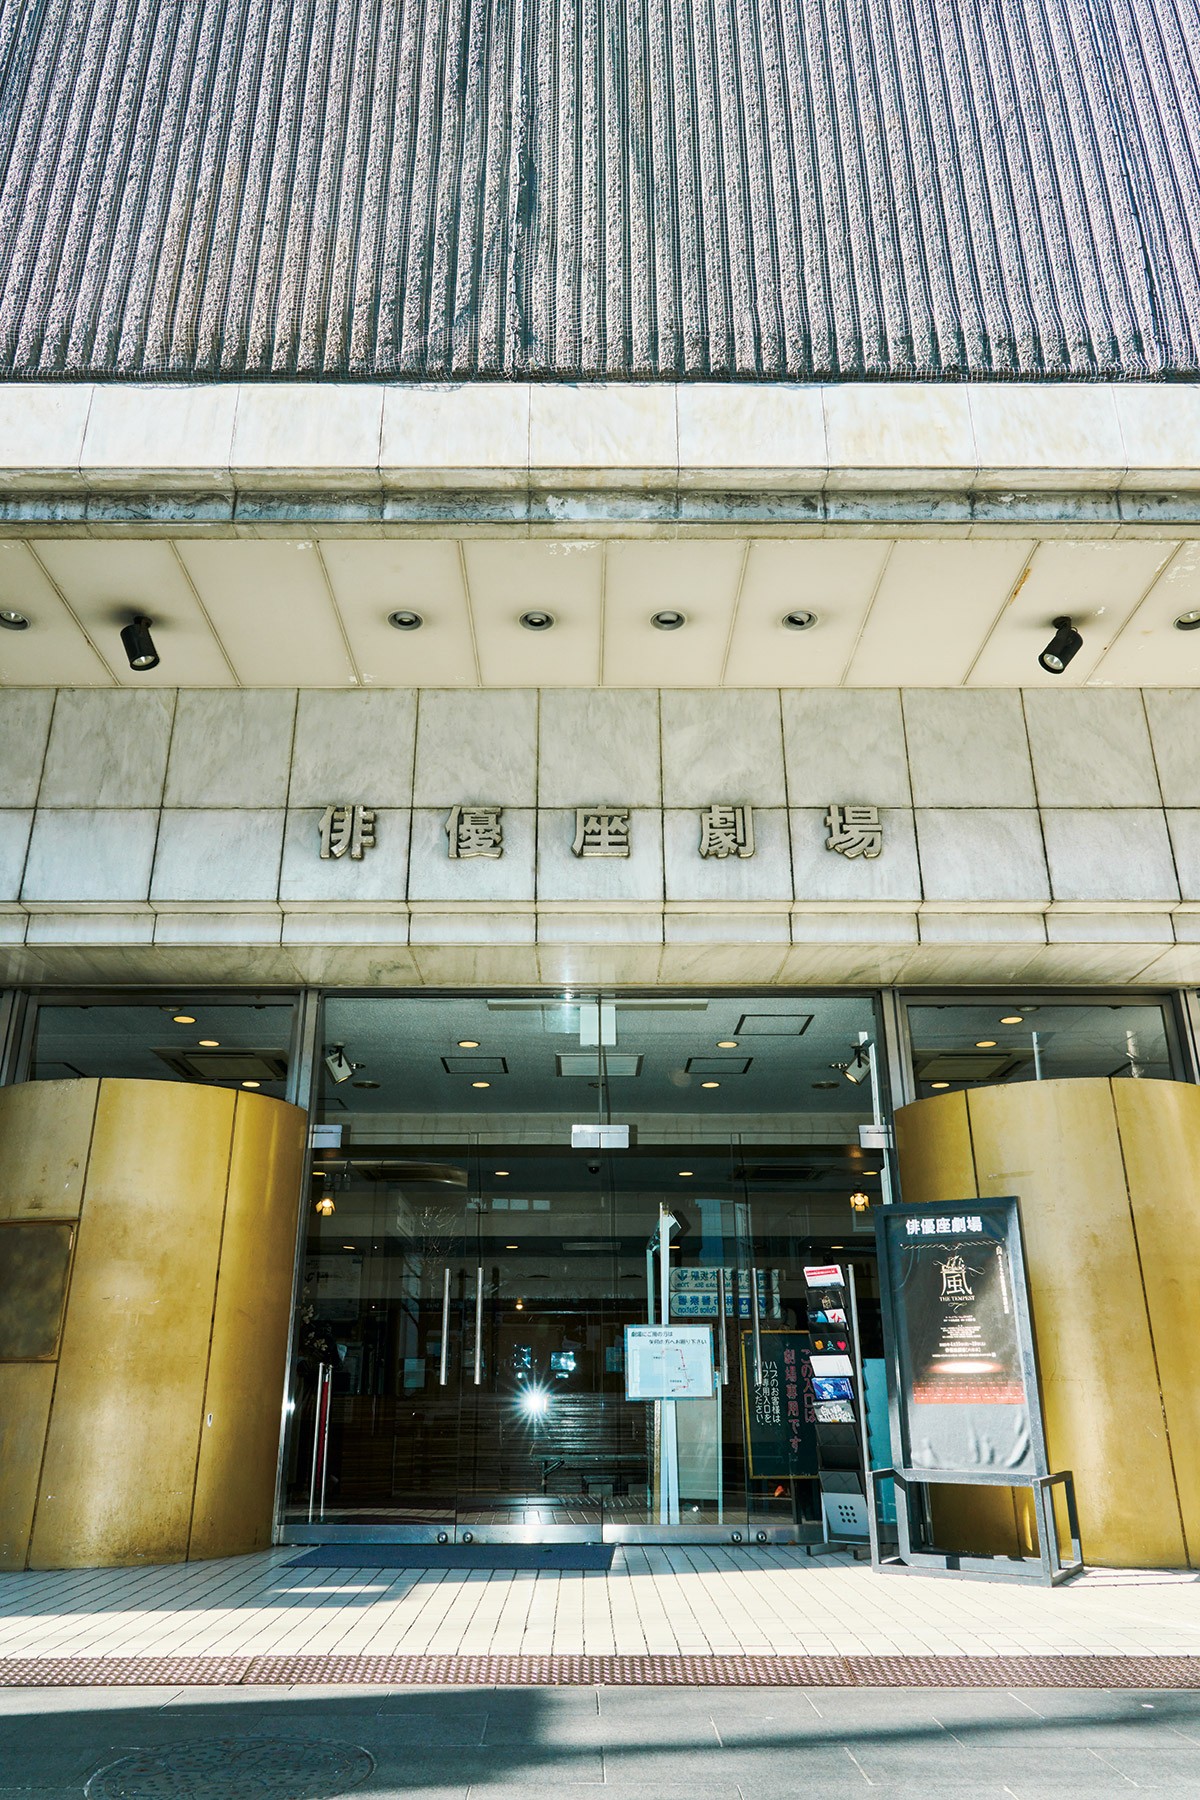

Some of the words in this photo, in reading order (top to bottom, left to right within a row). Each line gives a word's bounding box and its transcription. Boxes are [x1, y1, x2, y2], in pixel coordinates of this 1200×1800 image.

[318, 804, 884, 859] 俳優座劇場
[905, 1216, 983, 1235] 俳優座劇場
[784, 1349, 801, 1454] 劇場専用です
[801, 1349, 816, 1424] この入口は
